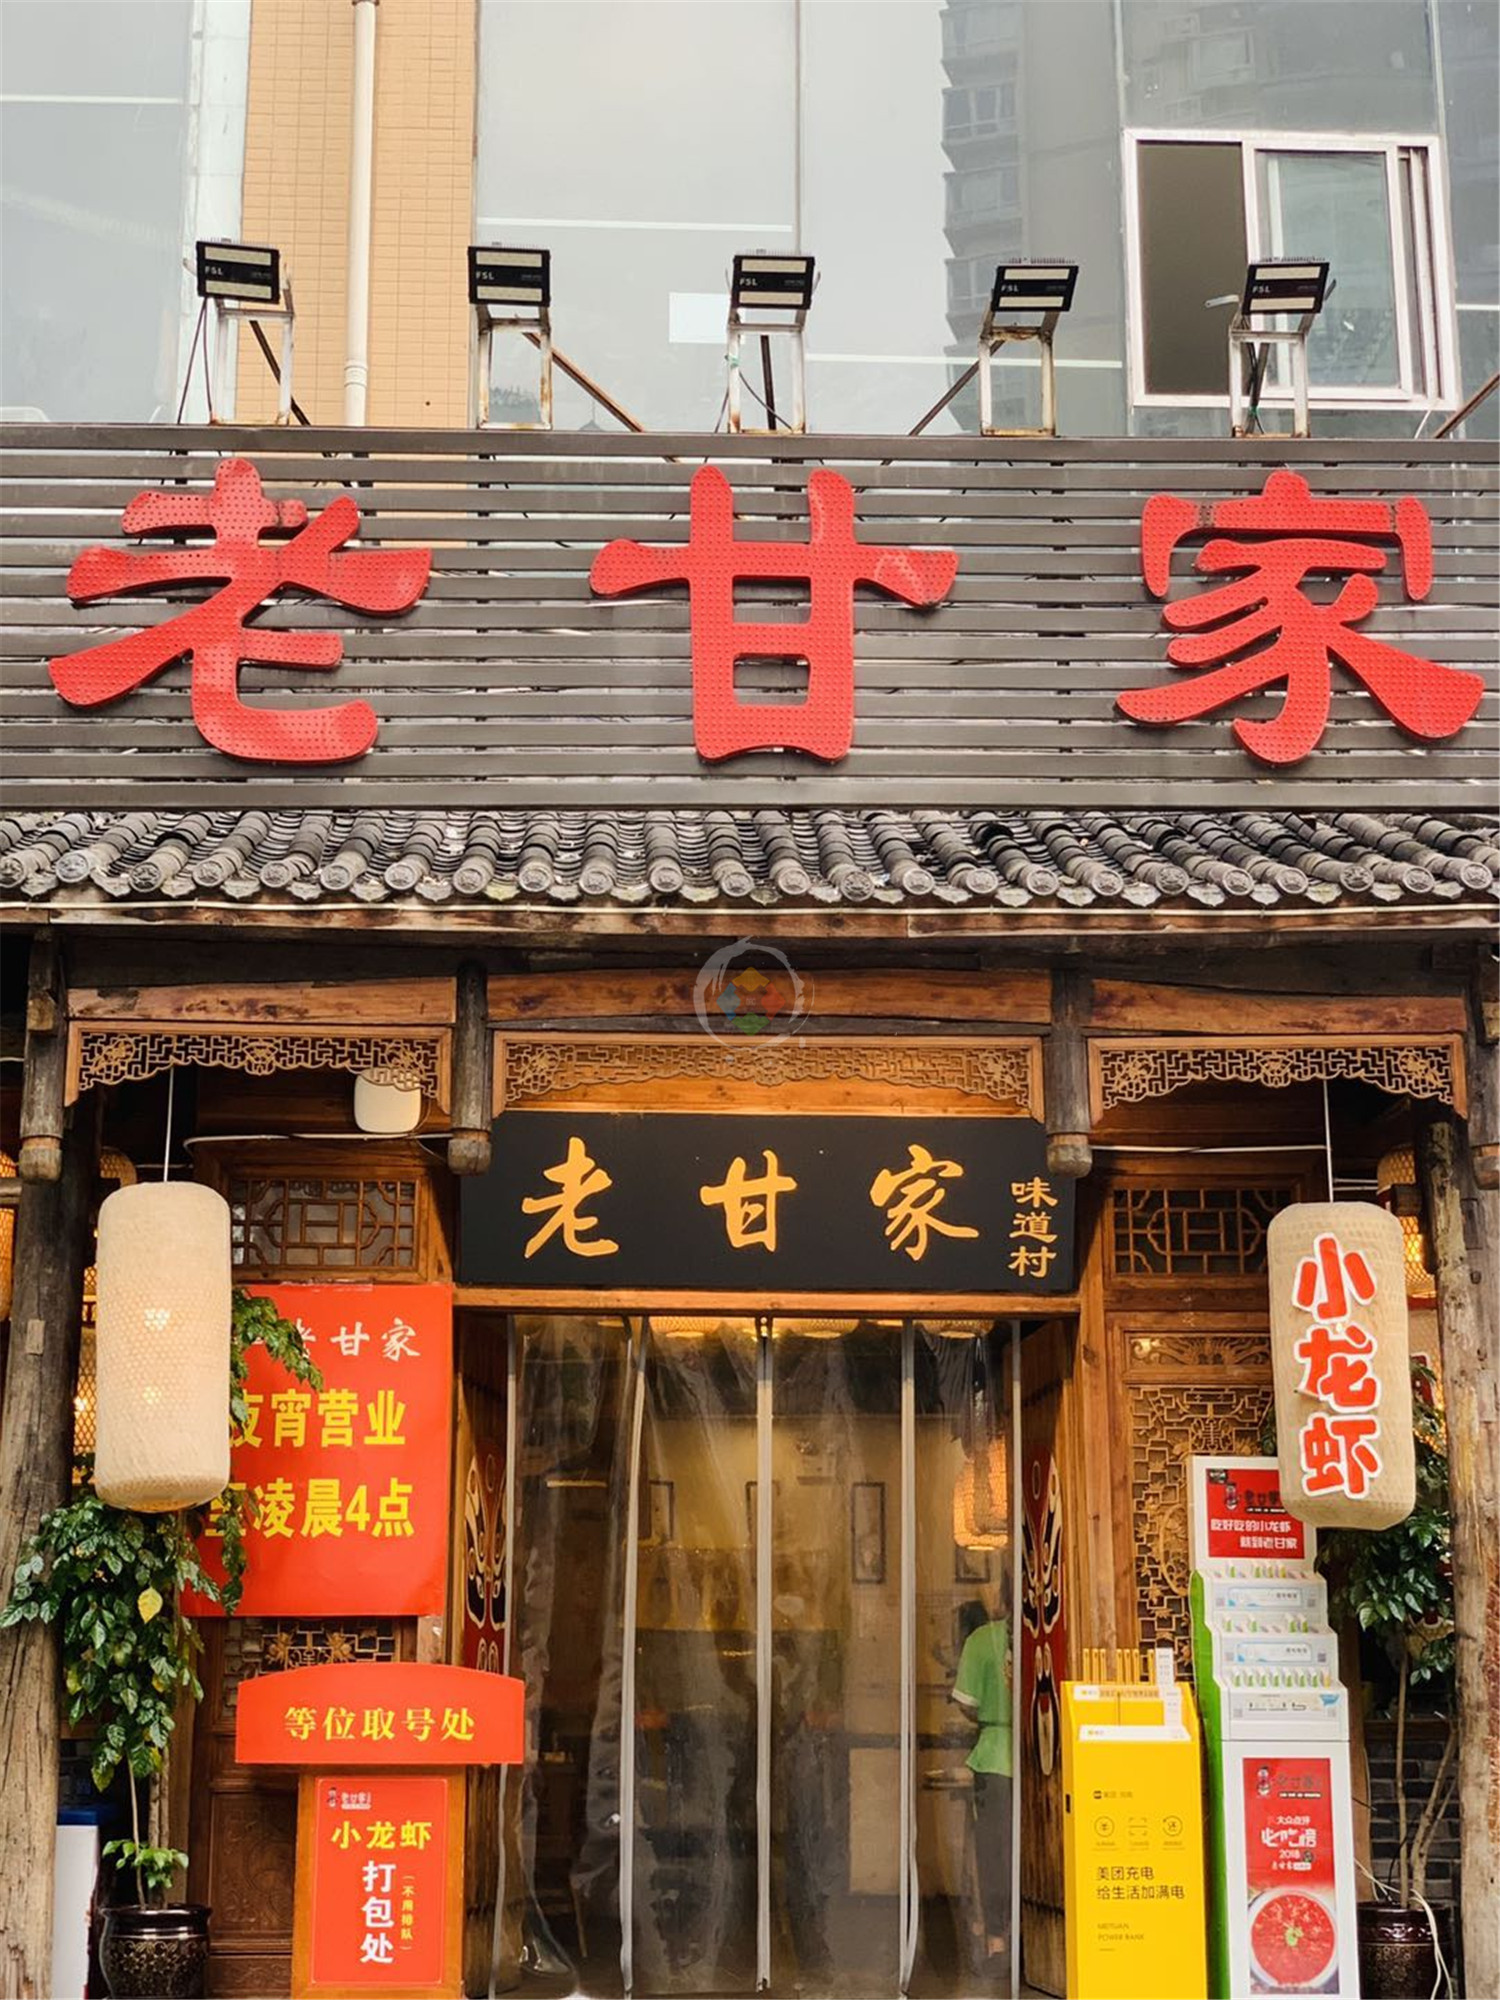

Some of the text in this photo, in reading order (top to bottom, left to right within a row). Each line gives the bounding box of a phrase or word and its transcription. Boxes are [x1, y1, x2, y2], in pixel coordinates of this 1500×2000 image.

[204, 265, 223, 276] FSL
[475, 271, 495, 280] FSL
[739, 278, 758, 286] FSL
[1001, 284, 1019, 292] FSL
[48, 457, 1484, 766] 老甘家
[521, 1136, 980, 1262] 老甘家
[1008, 1176, 1059, 1279] 味道村
[1293, 1233, 1380, 1499] 小龙虾
[284, 1707, 476, 1742] 等位取号处
[331, 1820, 432, 1850] 小龙虾
[1096, 1866, 1155, 1881] 美团充电
[1097, 1885, 1185, 1900] 给生活加满电
[360, 1859, 397, 1964] 打包处
